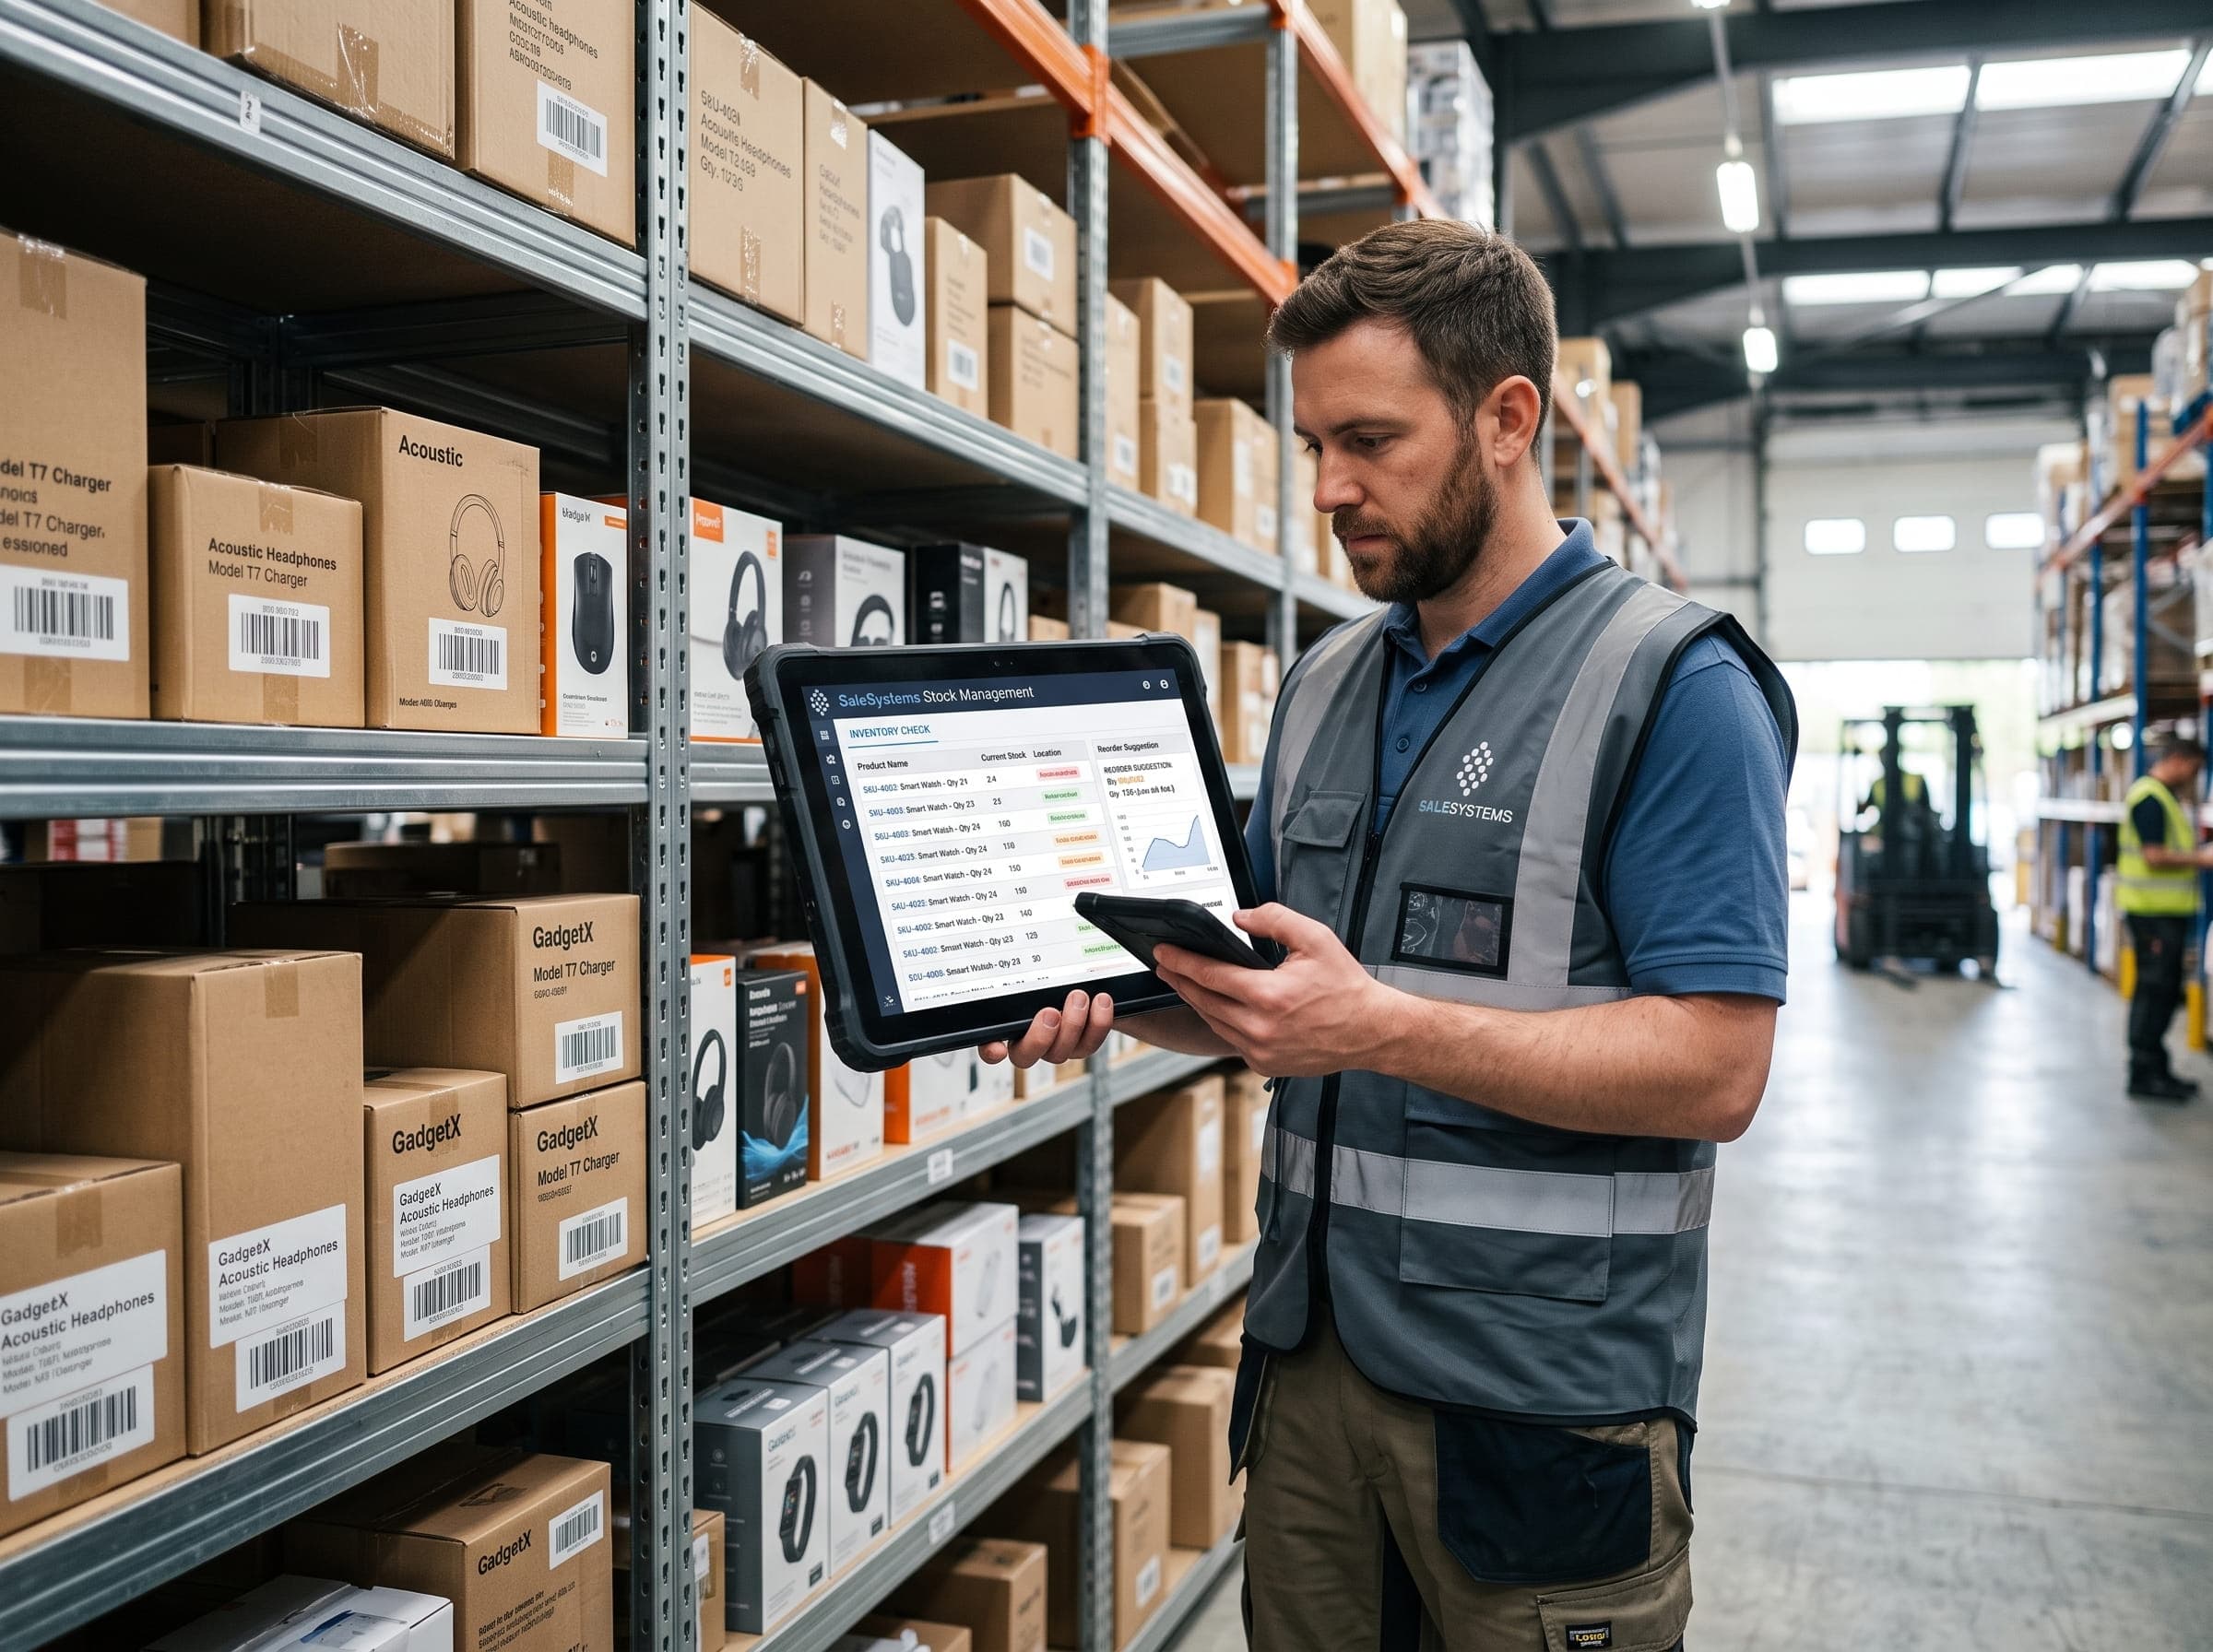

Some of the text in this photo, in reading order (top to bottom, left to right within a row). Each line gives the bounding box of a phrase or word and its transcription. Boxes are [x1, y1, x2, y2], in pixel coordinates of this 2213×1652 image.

[549, 17, 598, 59] headphones
[399, 435, 463, 467] Acoustic
[0, 459, 112, 493] del T7 Charger
[0, 509, 18, 526] del
[23, 511, 41, 528] T7
[208, 537, 337, 571] Acoustic Headphones
[208, 560, 308, 588] Model T7 Charger
[838, 686, 1035, 709] SaleSystems Stock Management
[849, 725, 931, 738] INVENTORY CHECK
[981, 750, 1027, 761] Current Stock
[1033, 749, 1061, 758] Location
[1097, 741, 1159, 753] Reorder Suggestion
[858, 760, 908, 772] Product Name
[900, 781, 919, 791] Smart
[905, 804, 926, 814] Smart
[1418, 799, 1513, 823] SALESYSTEMS
[917, 850, 939, 860] Smart
[939, 847, 961, 857] Watch
[922, 873, 942, 883] Smart
[943, 870, 964, 881] Watch
[928, 896, 948, 906] Smart
[949, 893, 970, 904] Watch
[988, 891, 998, 899] 24
[934, 919, 955, 930] Smart
[955, 916, 977, 927] Watch
[1020, 909, 1033, 917] 140
[533, 921, 594, 950] GadgetX
[963, 938, 984, 950] Watch
[534, 960, 616, 983] Model T7 Charger
[392, 1114, 462, 1153] GadgetX
[537, 1115, 598, 1152] GadgetX
[538, 1151, 621, 1186] Model T7 Charger
[399, 1186, 494, 1225] Acoustic Headphones
[219, 1240, 338, 1288] Acoustic Headphones
[1, 1292, 69, 1326] GadgetX
[1, 1292, 155, 1351] Acoustic Headphones
[478, 1529, 531, 1575] GadgetX
